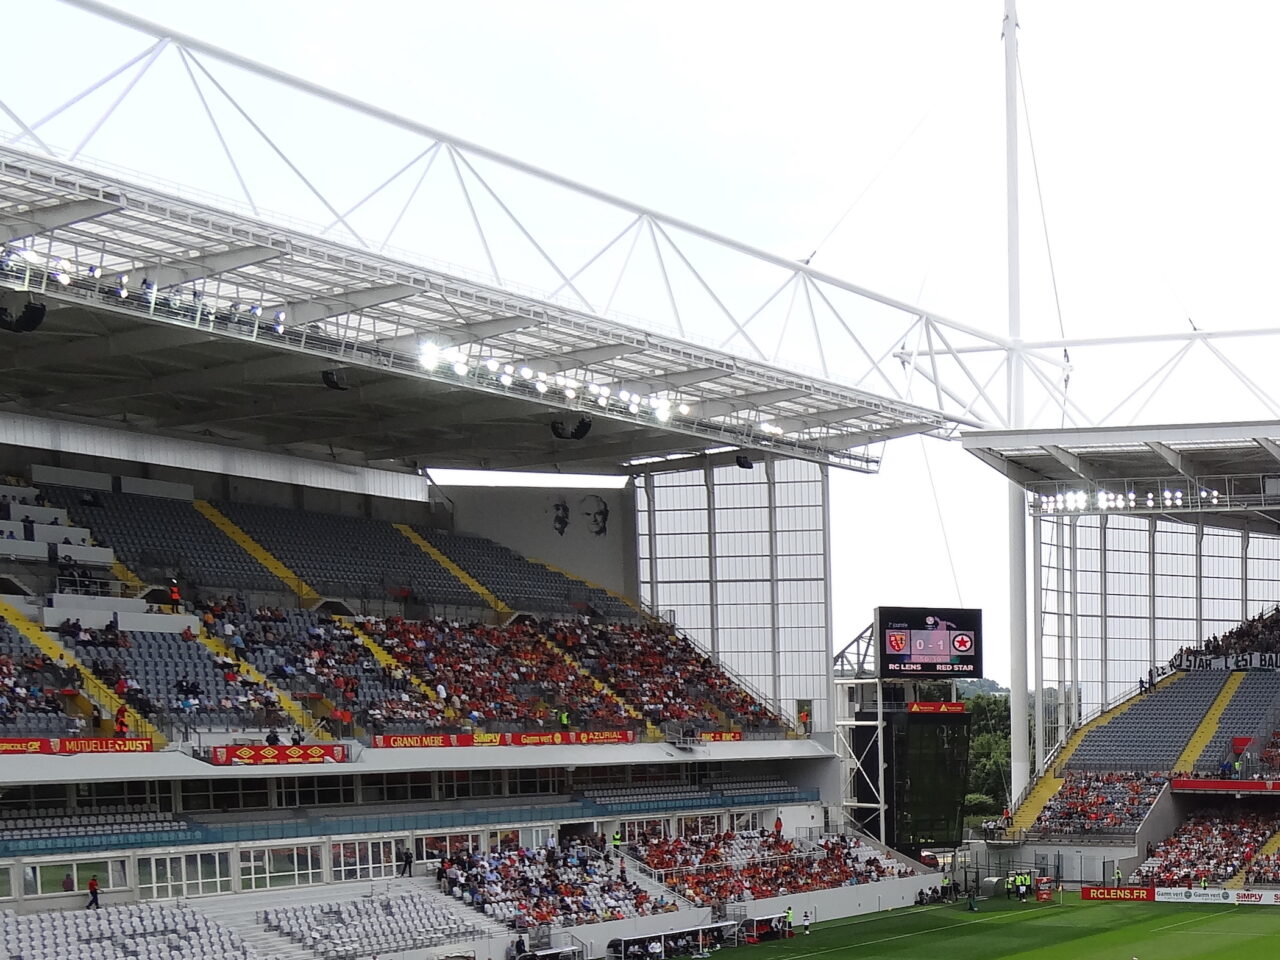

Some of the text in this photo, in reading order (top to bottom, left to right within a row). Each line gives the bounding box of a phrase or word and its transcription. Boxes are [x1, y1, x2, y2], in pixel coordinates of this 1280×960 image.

[916, 640, 924, 649] 0
[937, 640, 943, 649] 1
[540, 734, 553, 743] vert
[588, 731, 622, 739] AZURIAL
[66, 741, 115, 752] MUTUELLE
[1090, 889, 1147, 899] RCLENS.FR
